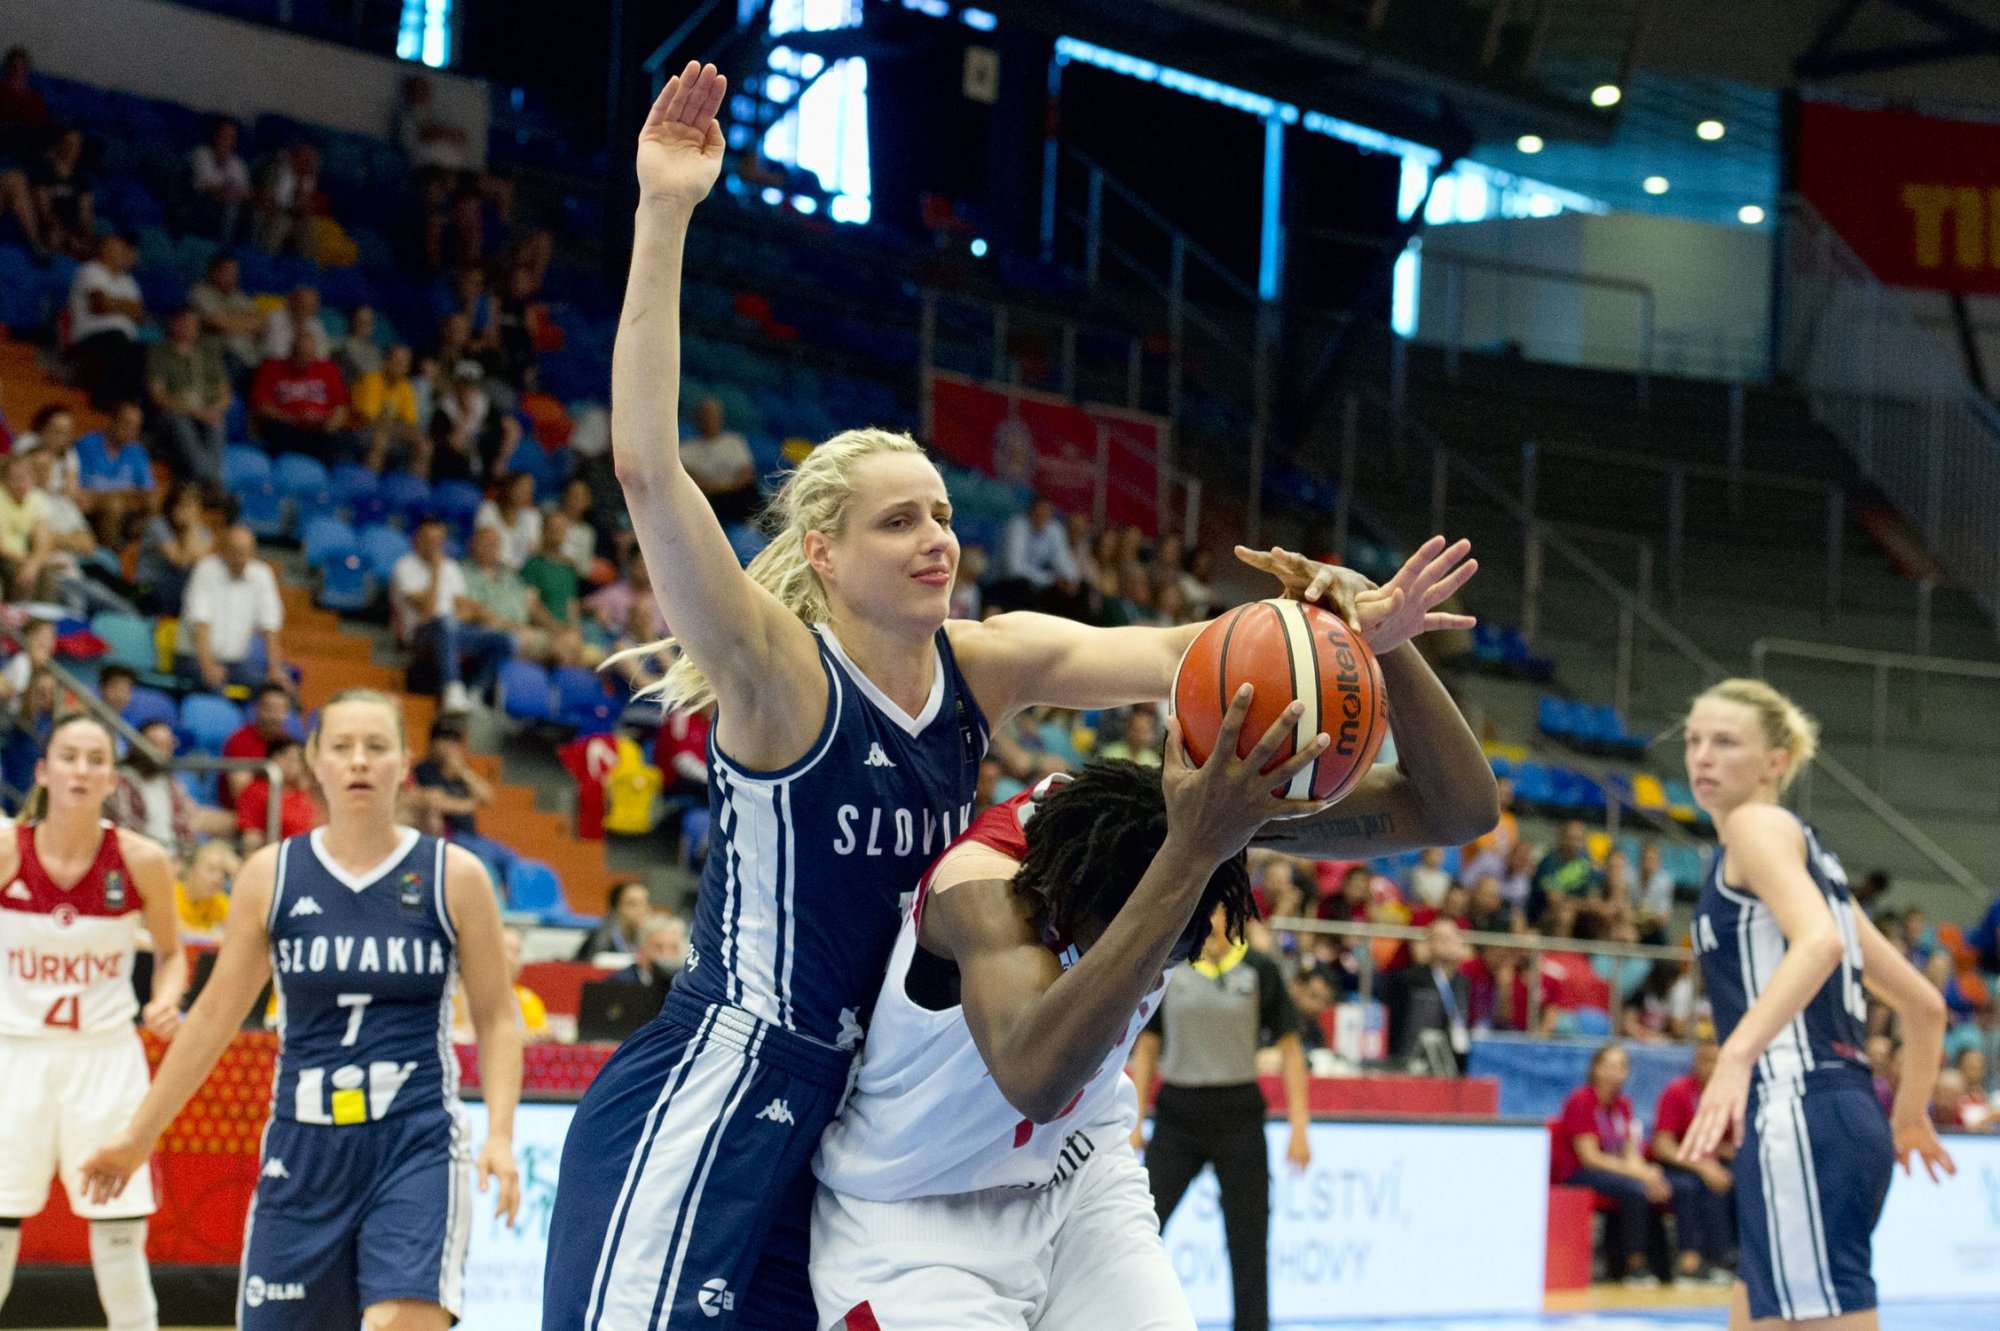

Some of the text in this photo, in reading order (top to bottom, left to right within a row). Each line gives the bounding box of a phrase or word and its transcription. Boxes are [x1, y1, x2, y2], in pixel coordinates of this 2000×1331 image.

[1327, 630, 1362, 756] molten
[278, 935, 445, 974] SLOVAKIA
[44, 995, 80, 1032] 4
[337, 993, 374, 1047] 7
